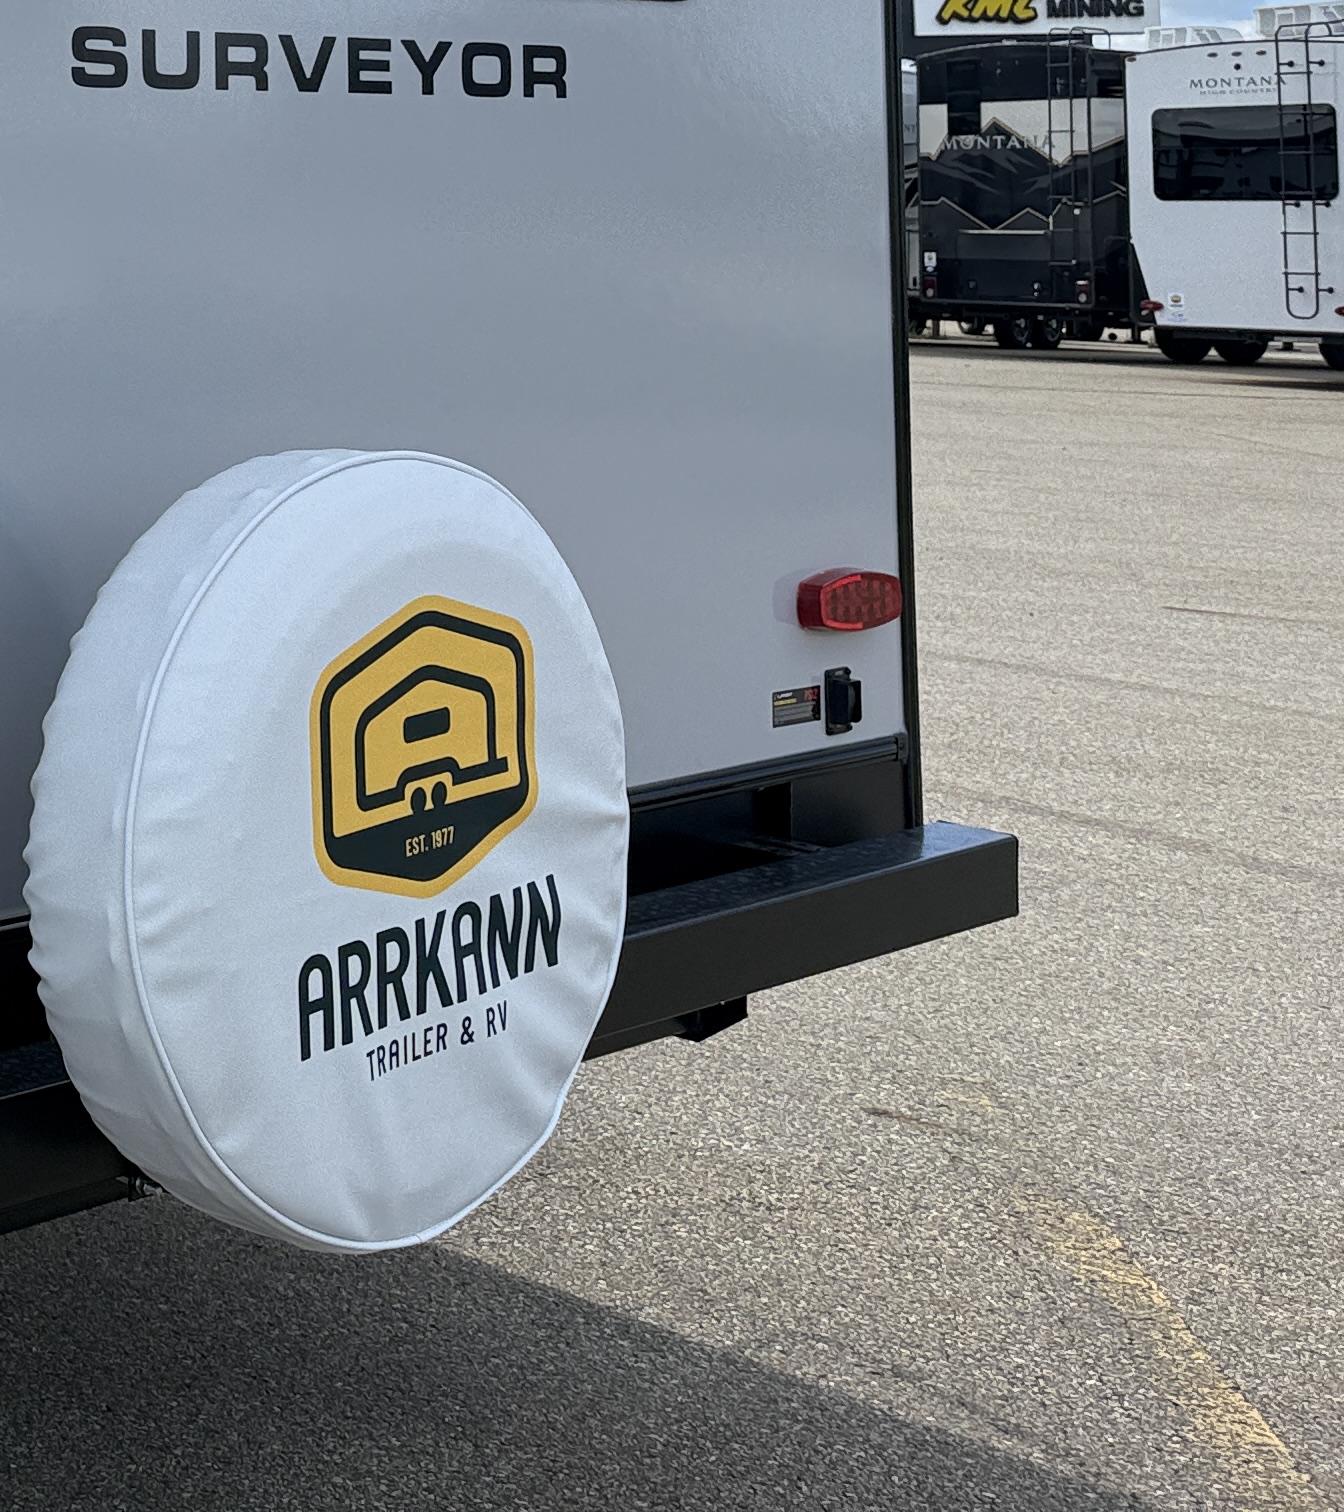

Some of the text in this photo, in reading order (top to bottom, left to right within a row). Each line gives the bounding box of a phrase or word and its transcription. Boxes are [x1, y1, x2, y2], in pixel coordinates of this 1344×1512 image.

[71, 26, 568, 99] SURVEYOR
[1189, 75, 1287, 89] MONTANA
[941, 134, 1056, 151] MONTANA
[405, 826, 455, 857] EST. 1977
[298, 874, 562, 1062] ARRKANN
[366, 1000, 508, 1081] TRAILER & RV
